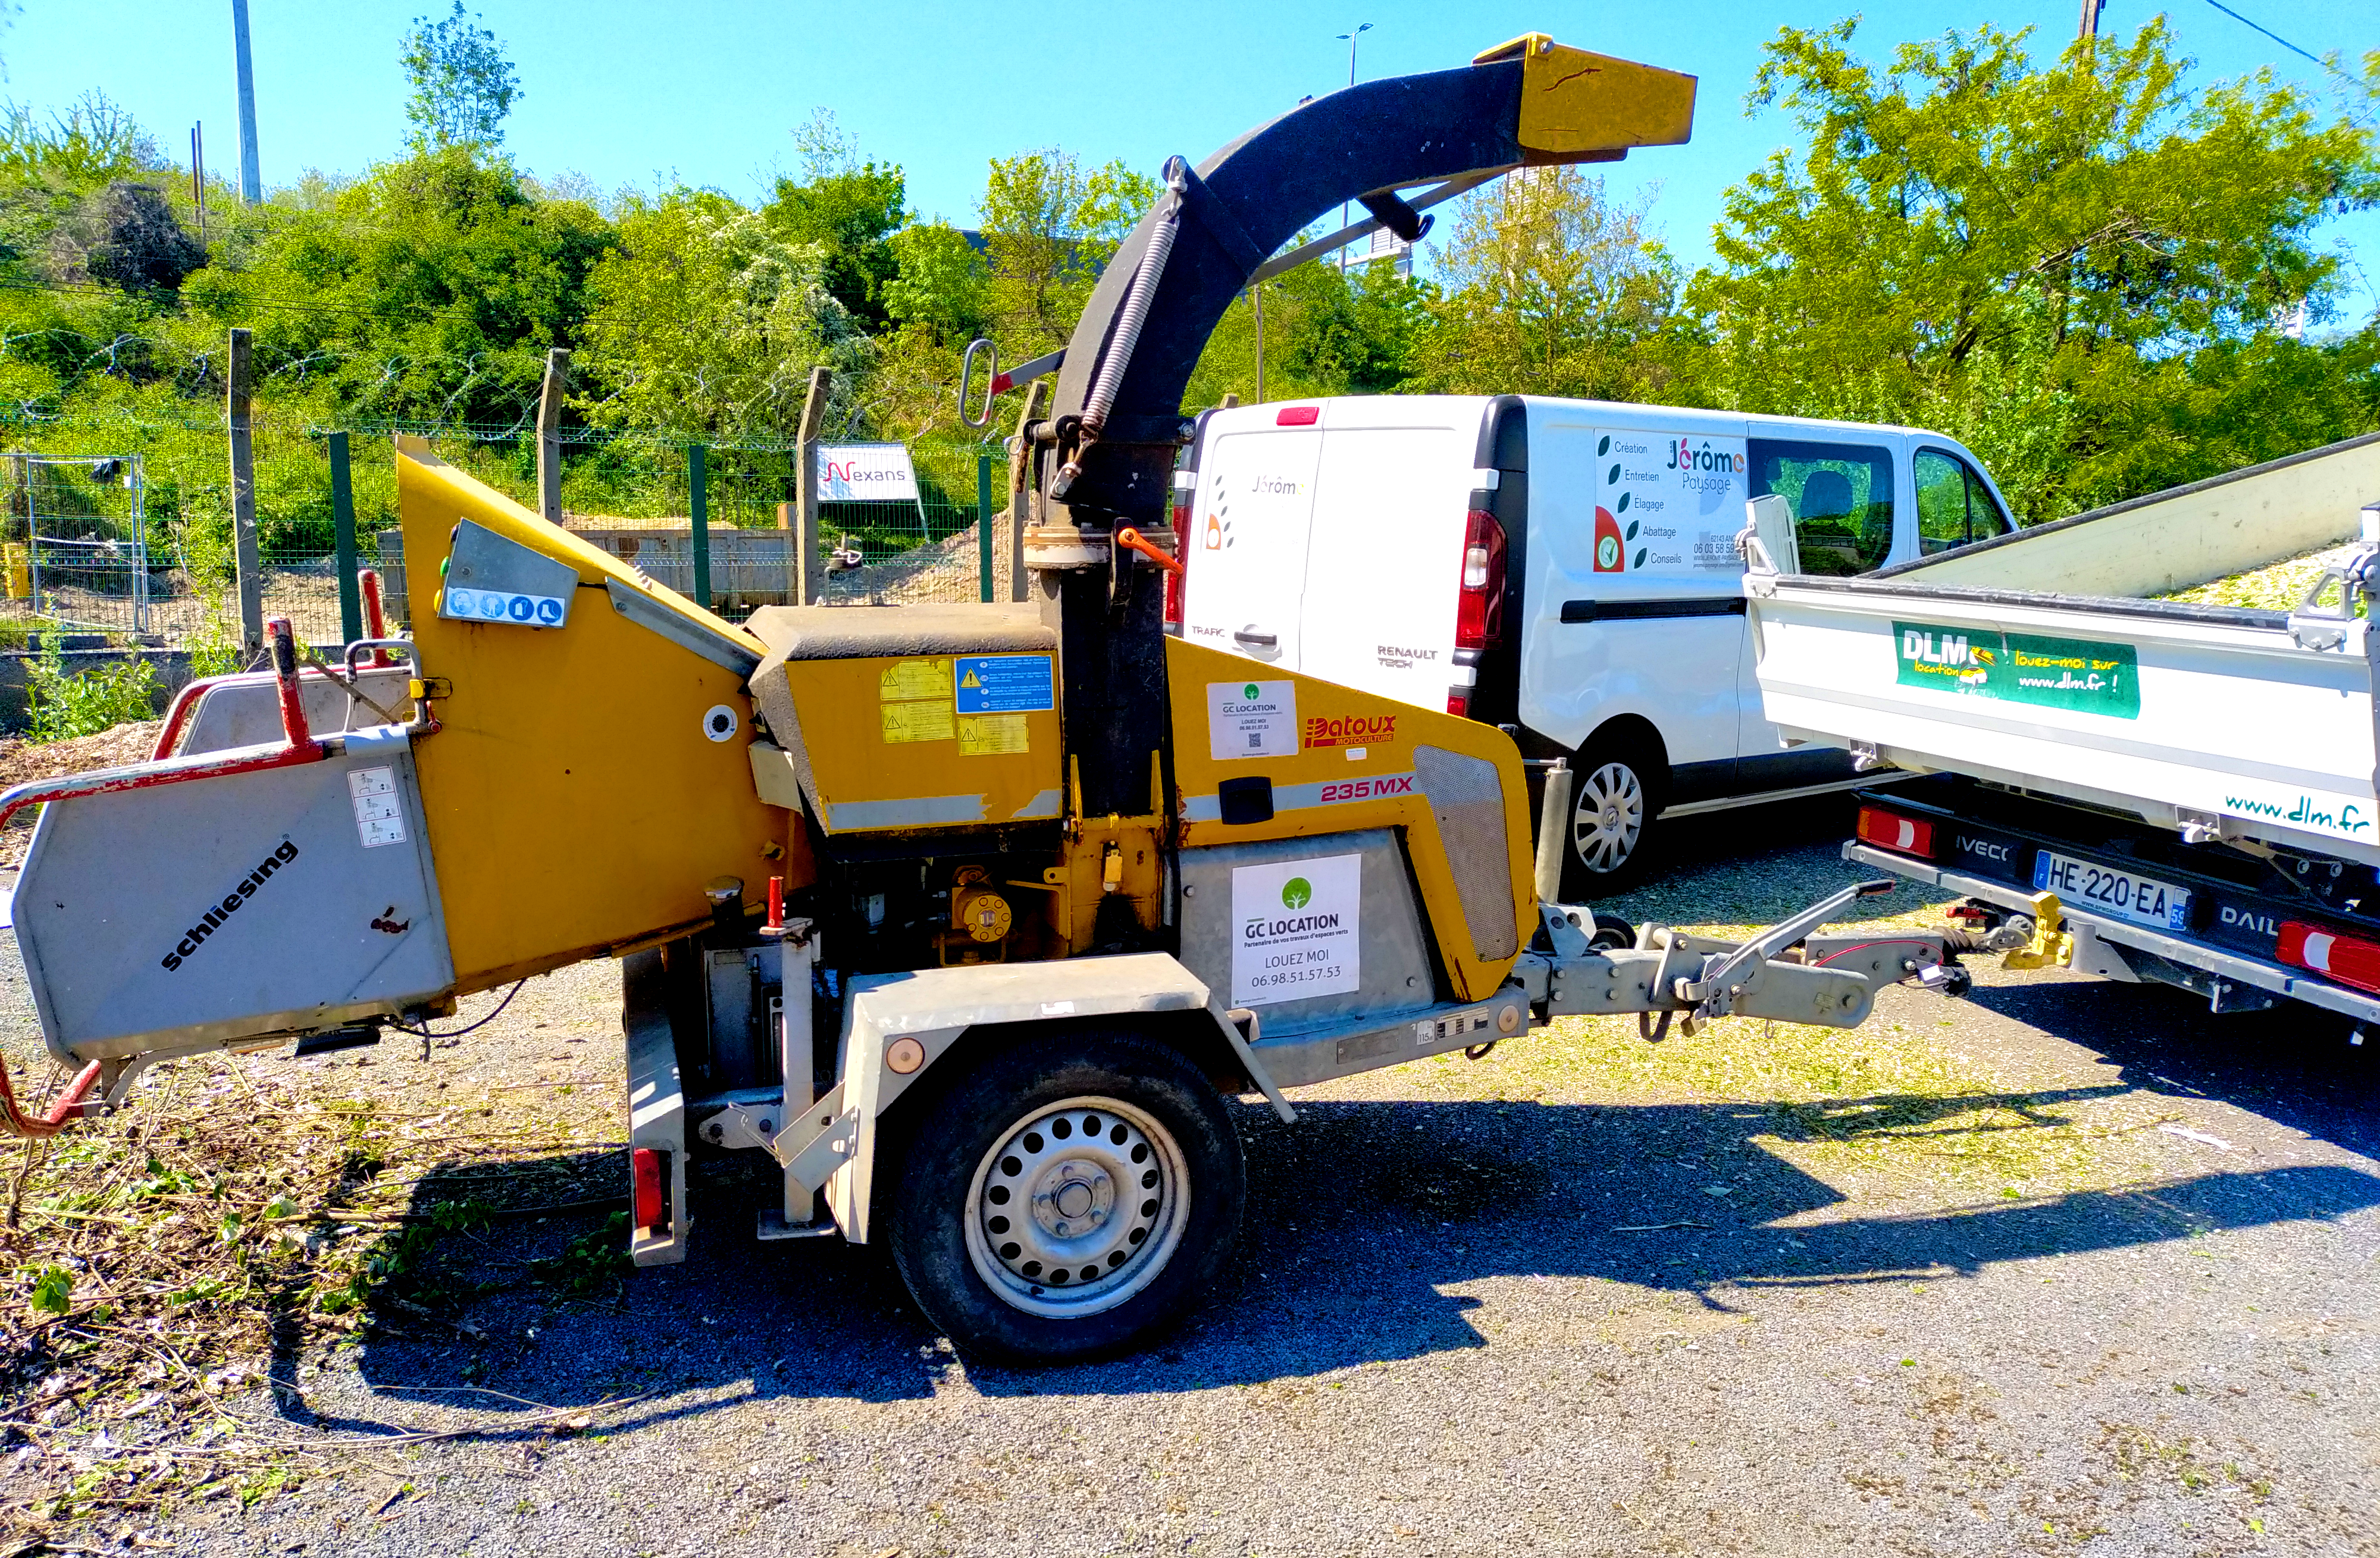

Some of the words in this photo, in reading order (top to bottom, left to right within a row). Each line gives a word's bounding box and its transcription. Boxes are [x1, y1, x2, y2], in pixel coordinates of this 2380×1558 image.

[1615, 441, 1648, 454] Création
[1667, 438, 1745, 473] Jérôme
[823, 462, 905, 481] Nexans
[1625, 469, 1659, 482] Entretien
[1683, 472, 1731, 494] Paysage
[1634, 494, 1664, 512] Élagage
[1643, 526, 1676, 539] Abattage
[1694, 543, 1703, 553] 06
[1705, 543, 1714, 553] 03
[1715, 543, 1724, 553] 58
[1726, 543, 1734, 553] 59
[1651, 553, 1681, 564] Conseils
[1192, 626, 1225, 637] TRAFIC
[1378, 645, 1438, 660] RENAULT
[1903, 630, 1968, 665] DLM
[1914, 659, 1959, 677] location
[2015, 649, 2086, 668] louez-moi
[2092, 659, 2119, 670] sur
[2019, 672, 2106, 691] www.dlm.fr
[1236, 704, 1276, 713] LOCATION
[1335, 733, 1393, 745] MOTOCULTURE
[1321, 781, 1370, 802] 235
[1374, 776, 1414, 796] MX
[2226, 795, 2370, 833] www.dlm.fr
[2038, 873, 2044, 881] F
[2050, 858, 2166, 919] HE-220-EA
[161, 840, 299, 973] schliesing
[2171, 908, 2185, 925] 59
[2221, 906, 2279, 936] DAIL
[1245, 923, 1266, 939] GC
[1269, 913, 1339, 936] LOCATION
[1244, 939, 1272, 948] Partenaire
[1266, 953, 1304, 968] LOUEZ
[1307, 949, 1329, 963] MOI
[1252, 965, 1341, 987] 06.98.51.57.53
